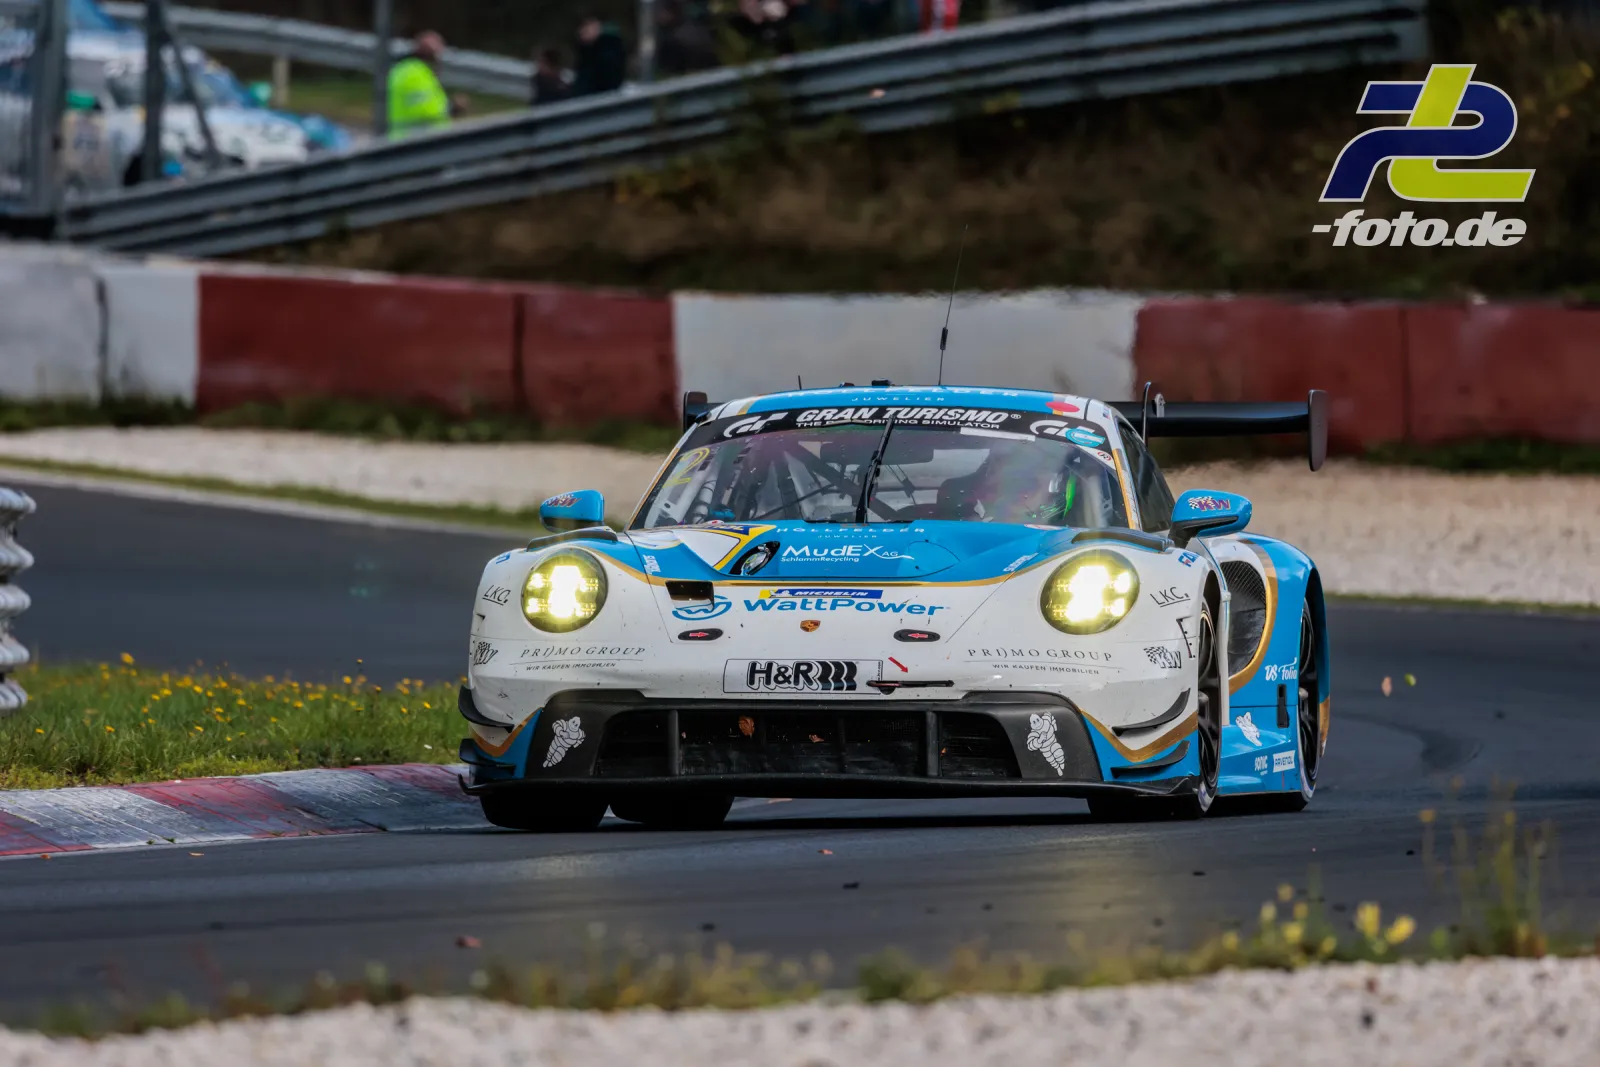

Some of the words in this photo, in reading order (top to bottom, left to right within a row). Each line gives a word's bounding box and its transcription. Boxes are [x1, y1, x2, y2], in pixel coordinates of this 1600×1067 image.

[796, 408, 878, 422] GRAN
[882, 407, 1009, 423] TURISMO
[921, 419, 1000, 429] SIMULATOR
[1198, 499, 1231, 511] KW
[781, 543, 884, 557] MudEX
[743, 599, 945, 616] WattPower
[585, 646, 646, 656] GROUP
[1046, 649, 1112, 661] GROUP
[748, 661, 819, 690] H&R
[1049, 666, 1100, 675] IMMOBILIEN
